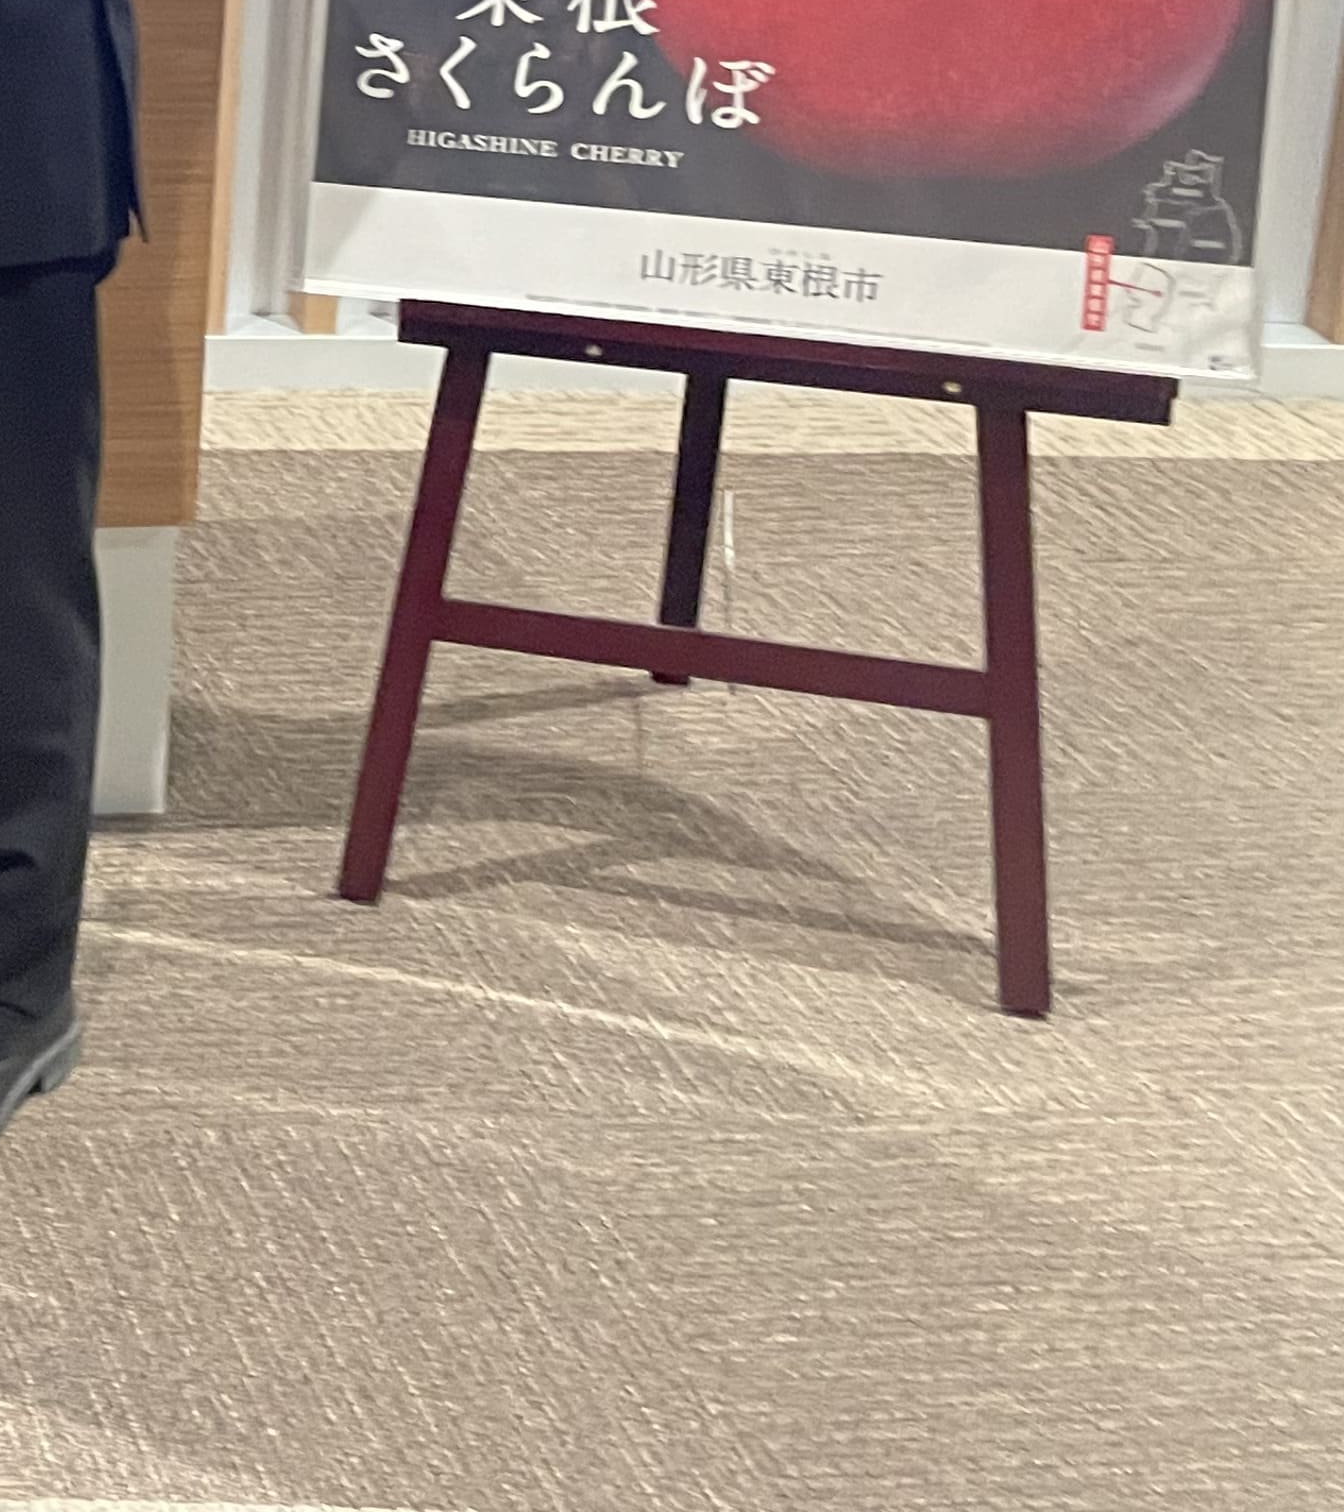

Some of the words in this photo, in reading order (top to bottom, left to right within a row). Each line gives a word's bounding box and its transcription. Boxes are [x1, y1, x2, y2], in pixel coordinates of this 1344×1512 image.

[354, 32, 776, 129] さくらんぼ
[406, 128, 559, 158] HIGASHINE
[570, 141, 686, 169] CHERRY
[640, 249, 884, 303] 山形県東根市
